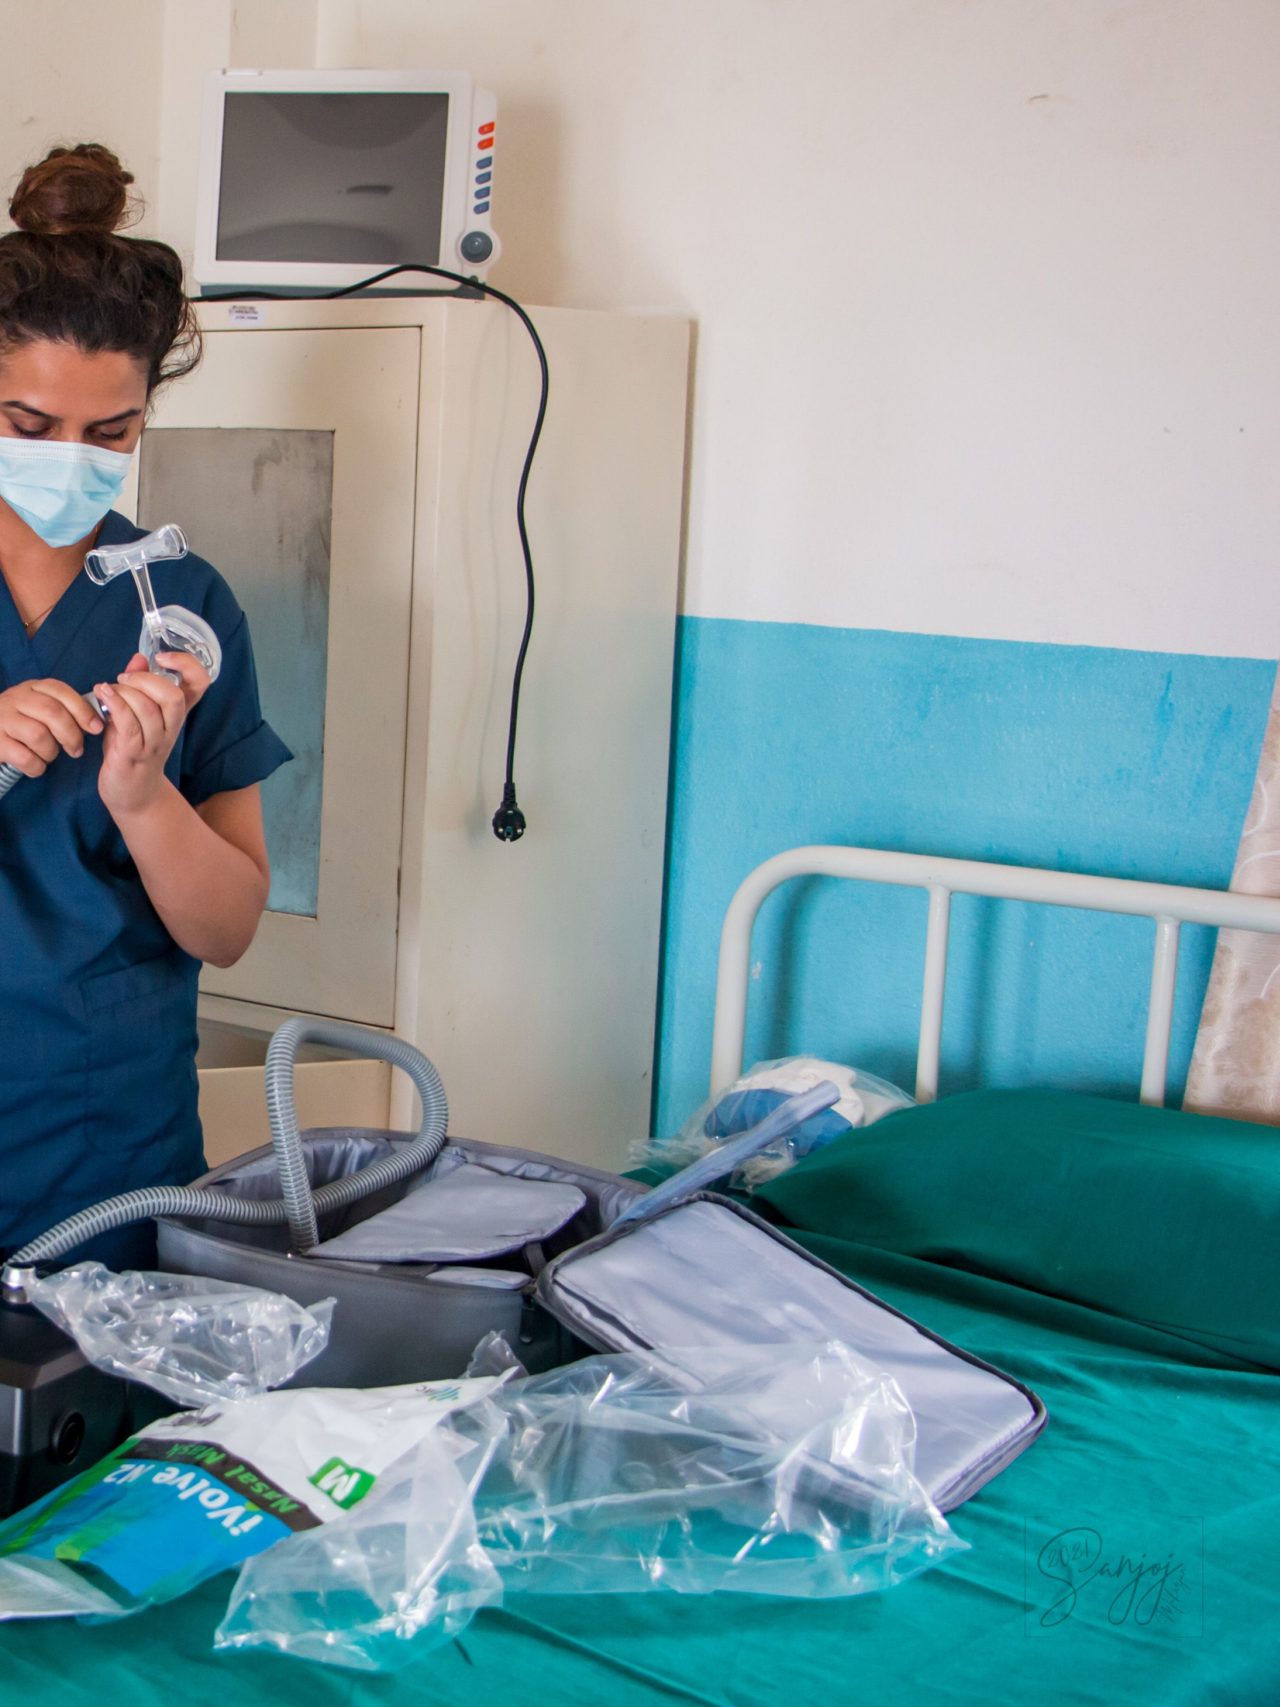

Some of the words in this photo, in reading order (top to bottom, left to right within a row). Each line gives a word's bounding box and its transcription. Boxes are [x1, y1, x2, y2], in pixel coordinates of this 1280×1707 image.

[166, 1443, 226, 1465] Mask
[103, 1464, 155, 1485] N2
[224, 1464, 299, 1513] Nasal
[318, 1465, 360, 1502] M
[151, 1466, 264, 1536] iVolve
